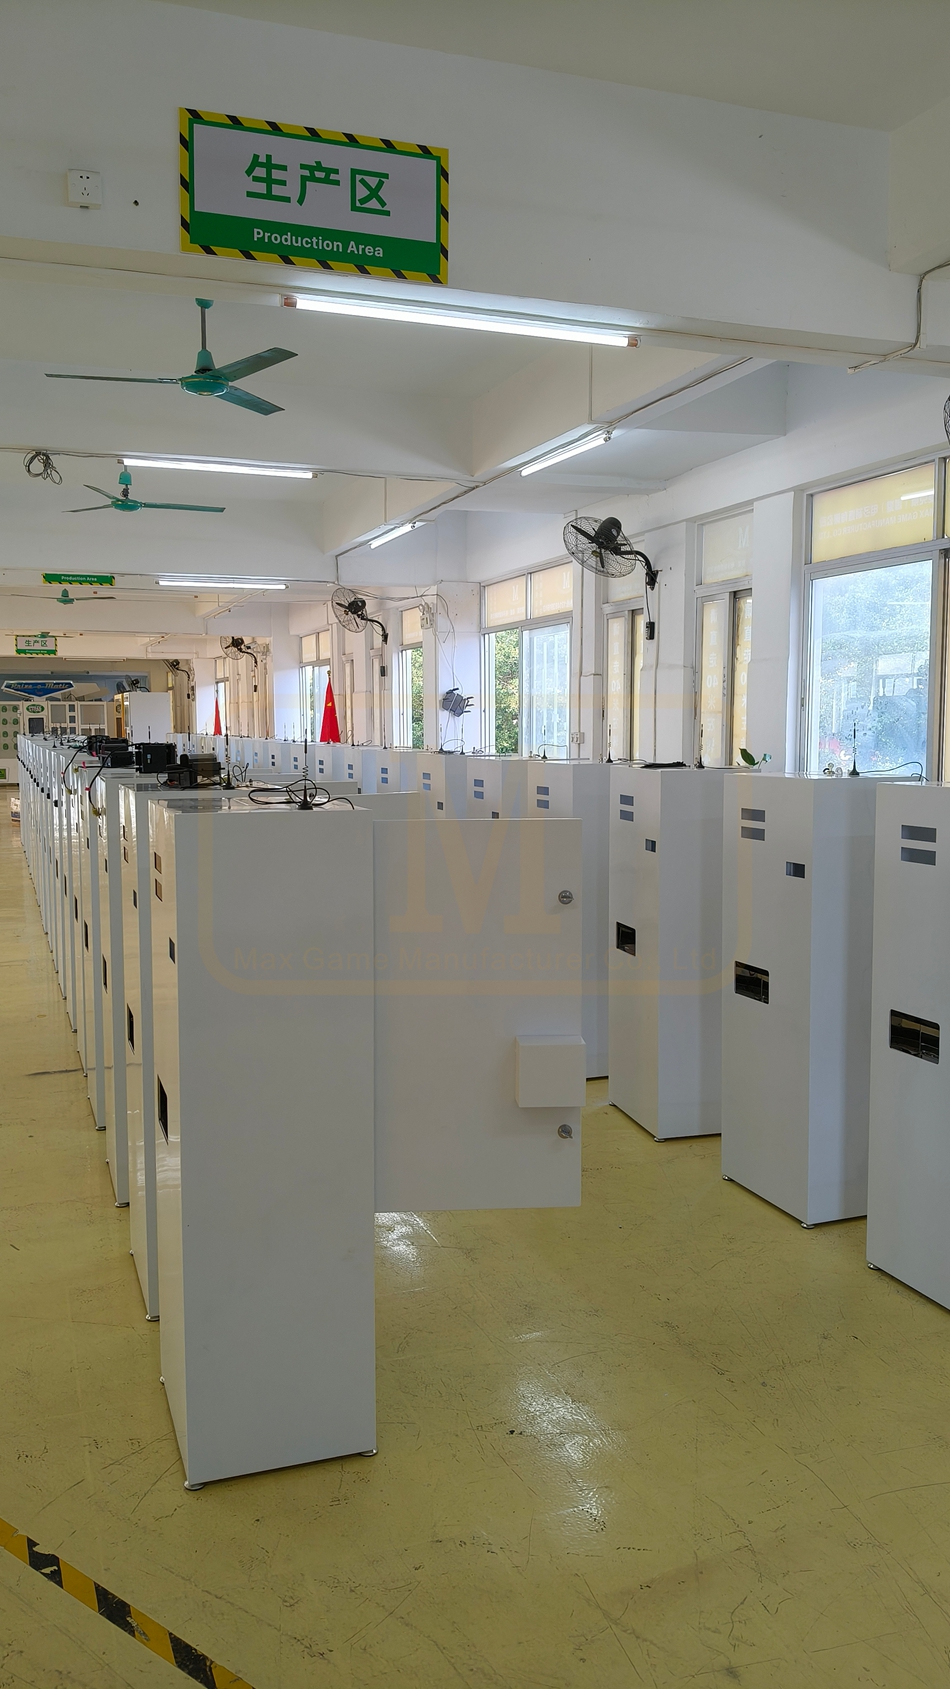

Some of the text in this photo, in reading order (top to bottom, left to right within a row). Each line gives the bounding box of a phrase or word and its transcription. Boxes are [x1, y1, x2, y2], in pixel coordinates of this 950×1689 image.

[245, 153, 391, 217] 生产区
[253, 228, 384, 258] Production Area
[24, 639, 49, 647] 生产区
